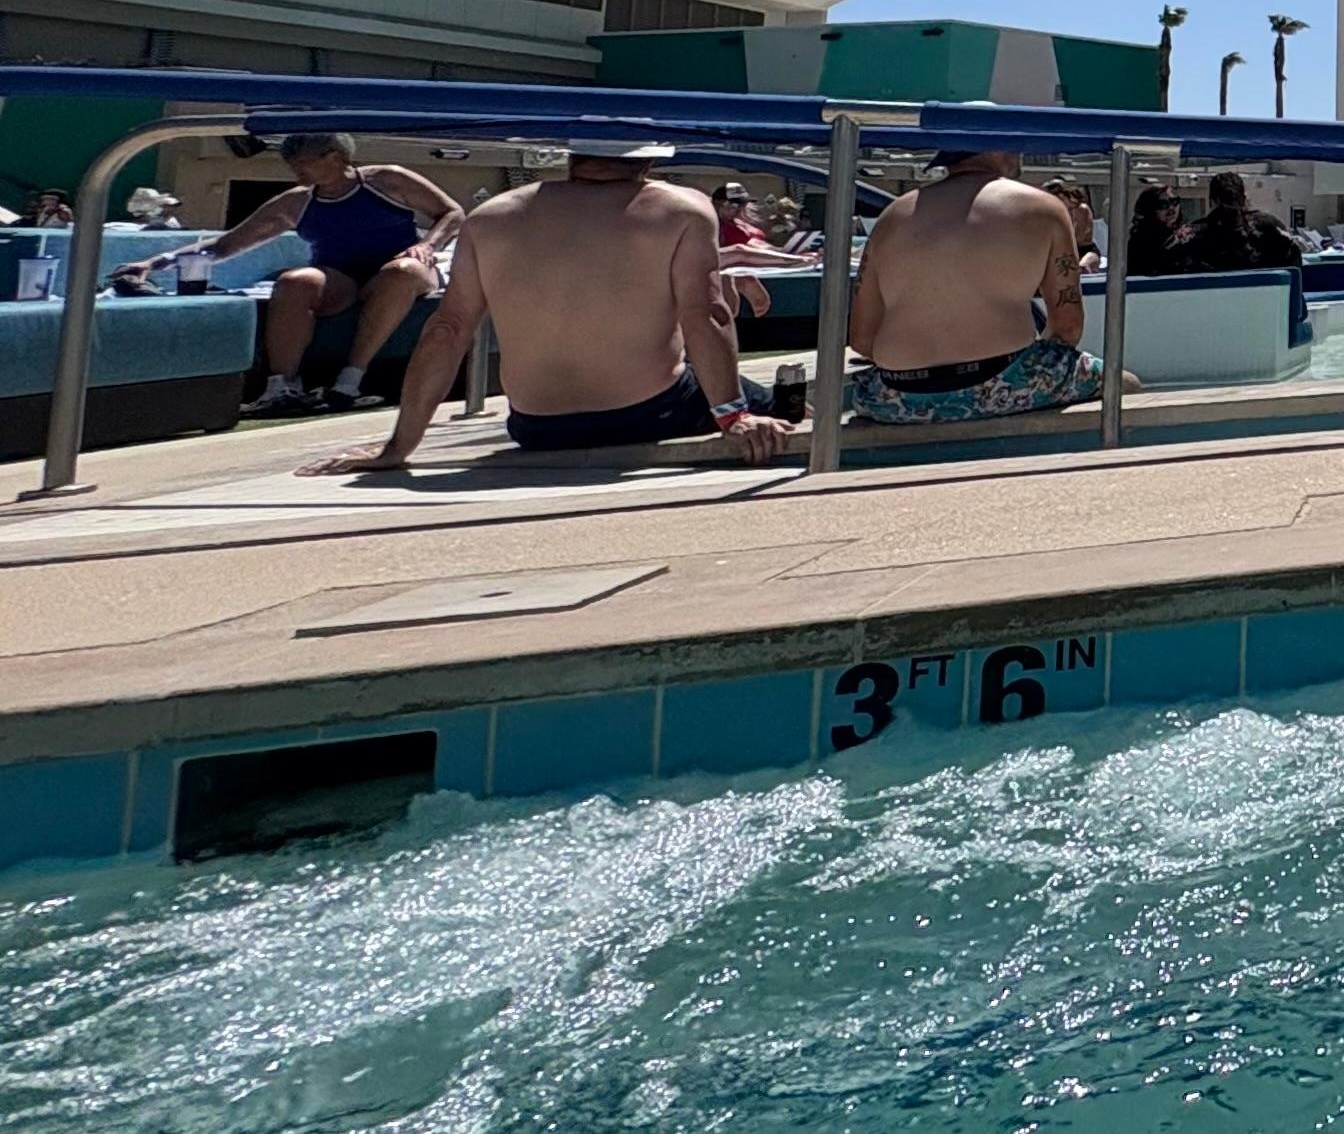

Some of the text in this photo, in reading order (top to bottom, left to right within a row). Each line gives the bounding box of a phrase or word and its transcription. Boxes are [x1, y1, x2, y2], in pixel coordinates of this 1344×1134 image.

[831, 636, 1097, 752] 3 FT 6 IN
